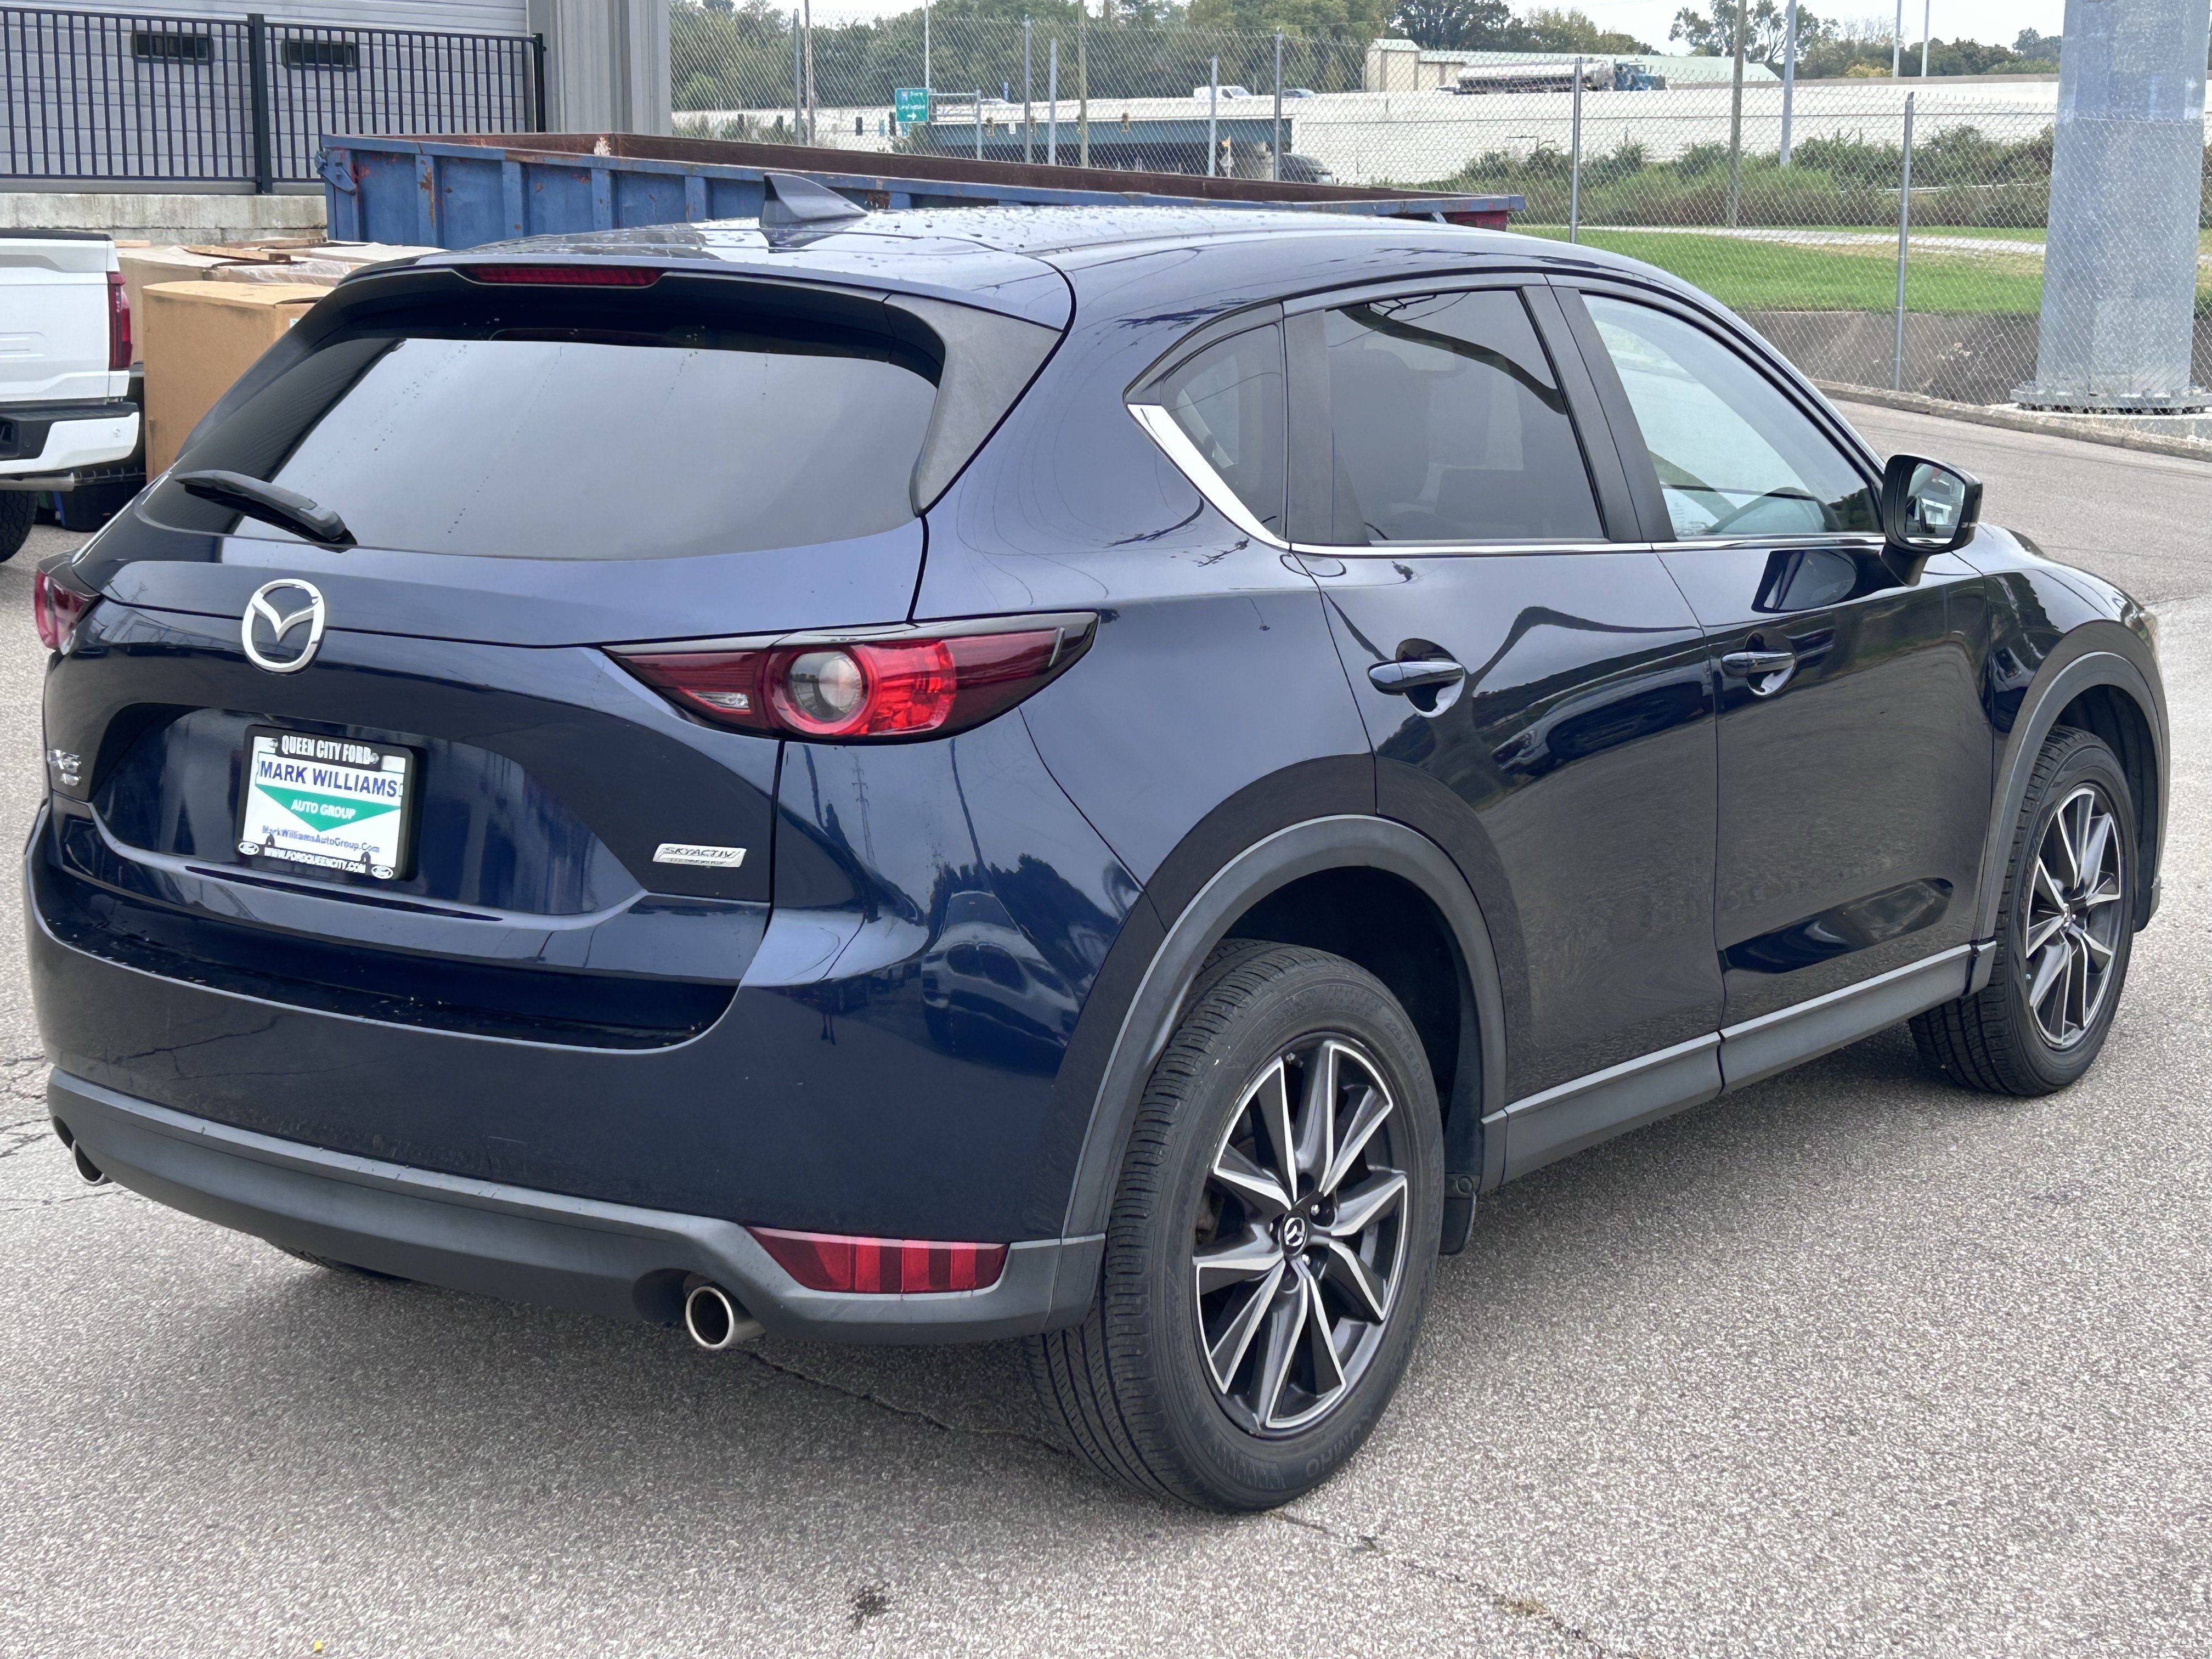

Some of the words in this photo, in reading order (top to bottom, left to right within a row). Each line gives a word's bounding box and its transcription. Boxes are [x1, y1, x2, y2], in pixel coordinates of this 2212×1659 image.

[281, 735, 315, 757] QUEEN
[317, 740, 342, 761] CITY
[342, 744, 372, 765] FORD
[259, 760, 308, 785] MARK
[313, 768, 398, 798] WILLIAMS
[291, 799, 319, 814] AUTO
[320, 803, 357, 820] GROUP
[663, 847, 737, 859] SKYACTIV
